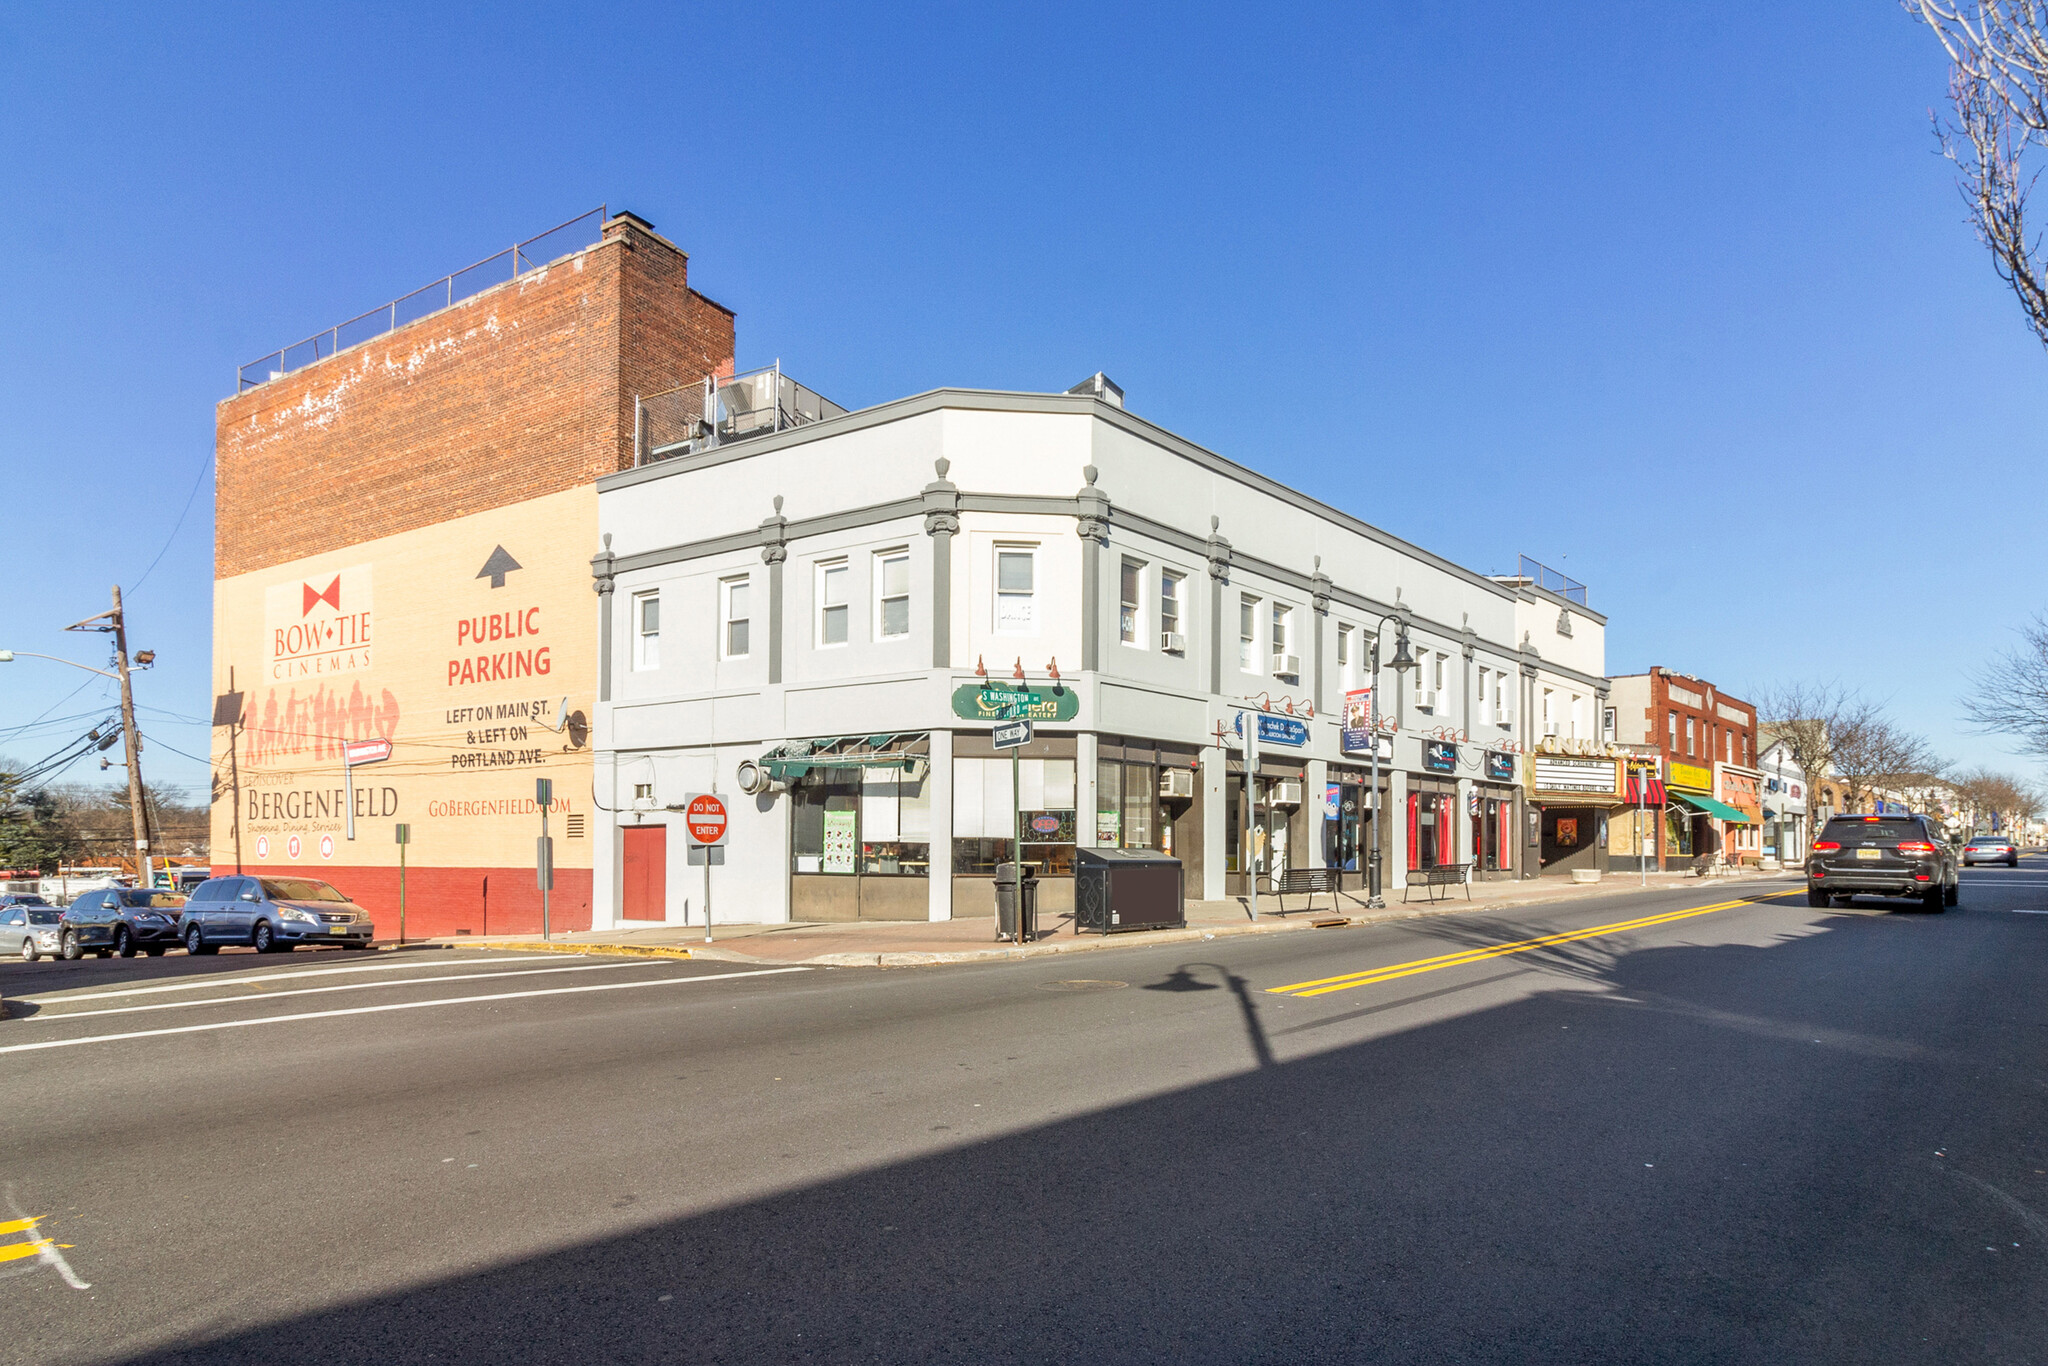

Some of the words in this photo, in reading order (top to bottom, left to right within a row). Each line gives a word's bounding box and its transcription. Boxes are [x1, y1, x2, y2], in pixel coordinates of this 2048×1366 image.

[274, 620, 325, 657] BOW
[335, 611, 370, 646] TIE
[458, 606, 540, 646] PUBLIC
[273, 649, 370, 679] CINEMAS
[448, 646, 551, 686] PARKING
[982, 691, 988, 701] S
[990, 692, 1029, 703] WASHINGTON
[446, 708, 474, 724] LEFT
[476, 705, 493, 721] ON
[496, 702, 529, 719] MAIN
[532, 700, 550, 716] ST.
[467, 730, 476, 745] &
[478, 727, 506, 744] LEFT
[509, 725, 528, 741] ON
[997, 731, 1008, 740] ONE
[1010, 728, 1020, 738] WAY
[451, 750, 515, 768] PORTLAND
[518, 748, 546, 765] AVE.
[243, 774, 295, 787] REDISCOVER
[248, 787, 398, 820] BERGENFELD
[693, 803, 704, 812] DO
[706, 803, 720, 812] NOT
[311, 820, 343, 832] Services
[696, 826, 719, 835] ENTER
[1032, 819, 1059, 830] OPEN
